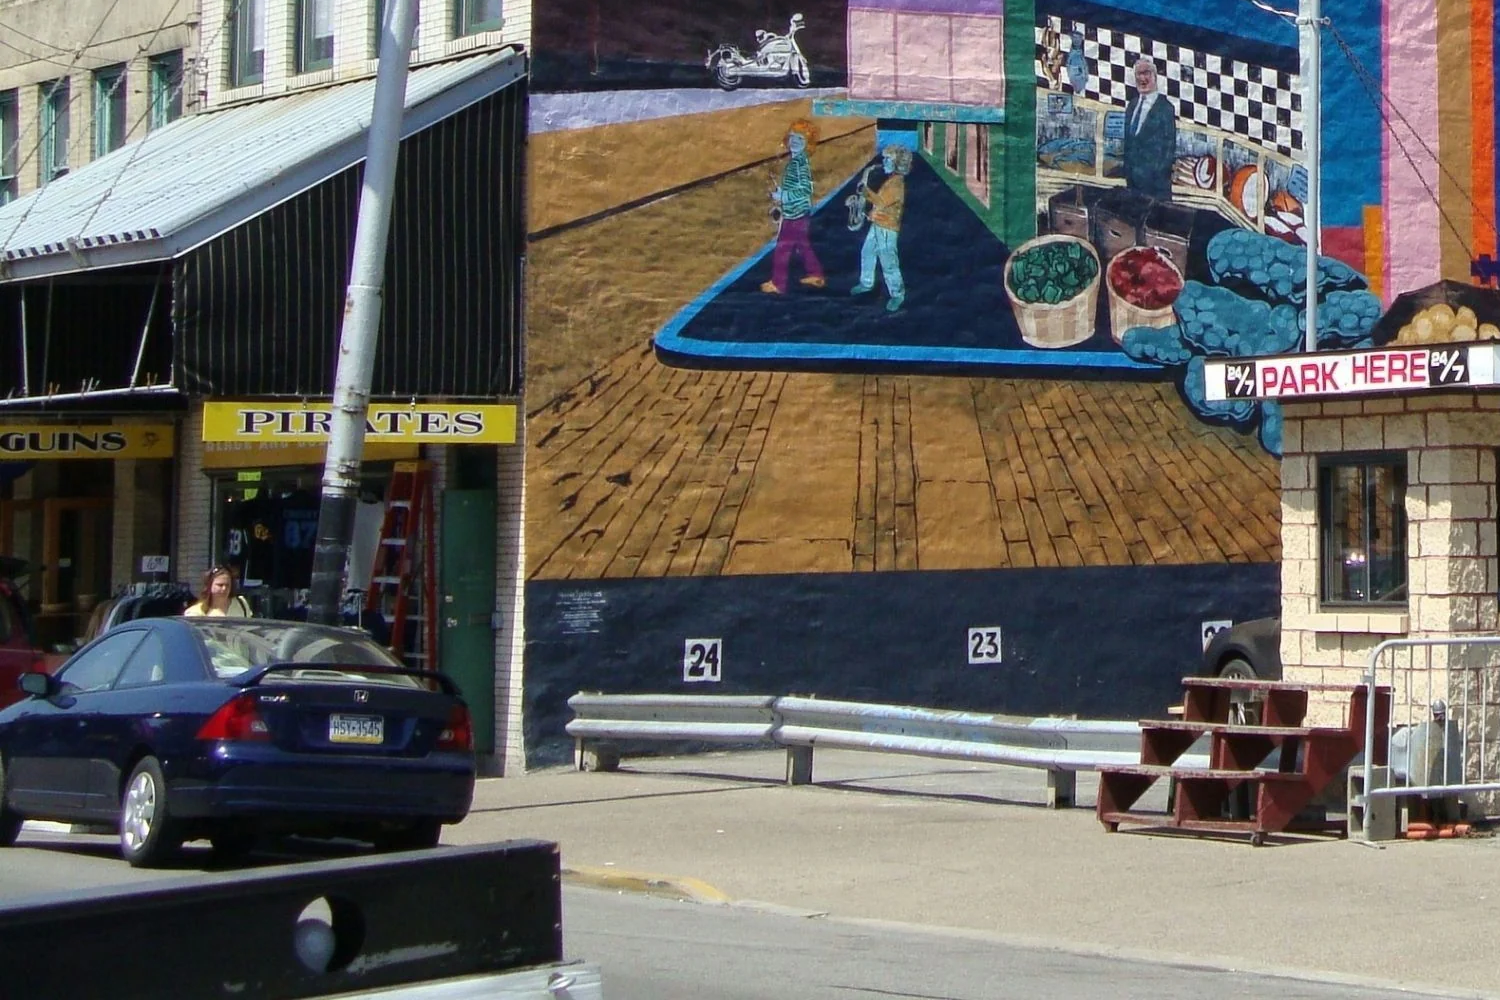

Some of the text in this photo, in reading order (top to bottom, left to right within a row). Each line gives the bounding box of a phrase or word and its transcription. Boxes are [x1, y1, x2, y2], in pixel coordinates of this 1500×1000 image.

[1262, 361, 1339, 395] PARK
[1352, 352, 1426, 384] HERE
[1430, 349, 1465, 383] 24/7
[239, 410, 484, 434] PIRTES
[971, 632, 998, 657] 23
[689, 643, 718, 676] 24
